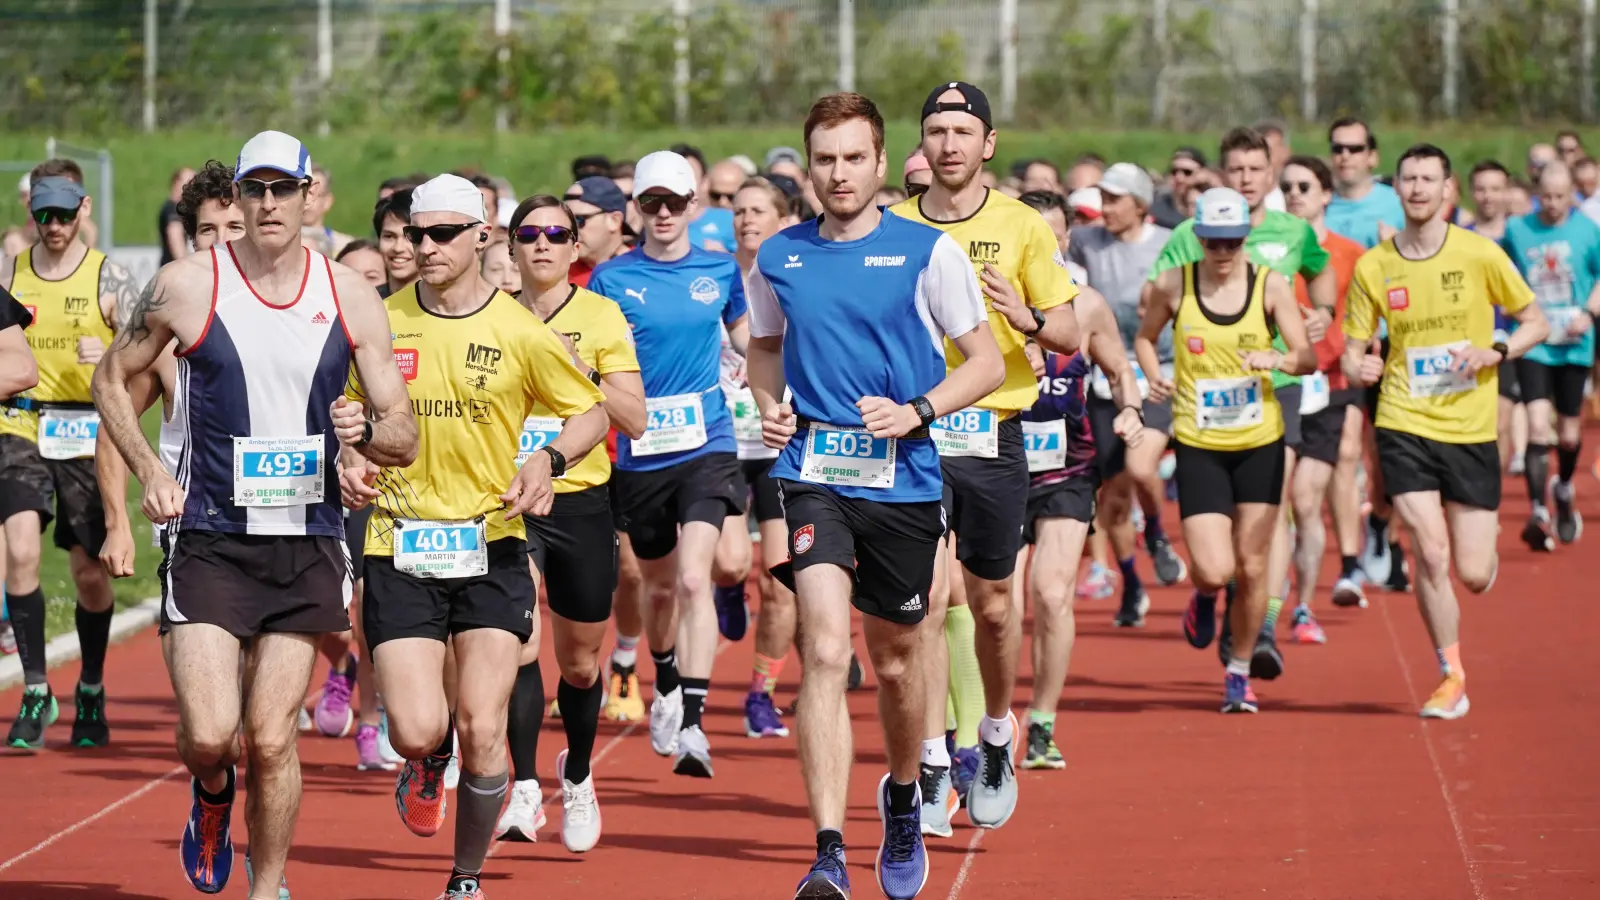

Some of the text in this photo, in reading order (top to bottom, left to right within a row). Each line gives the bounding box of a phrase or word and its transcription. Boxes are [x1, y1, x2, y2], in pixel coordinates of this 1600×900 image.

[969, 241, 1001, 258] MTP
[864, 256, 906, 267] SPORTCAMP
[65, 297, 89, 311] MTP
[466, 343, 502, 367] MTP
[465, 361, 498, 375] Hersbruck
[646, 408, 687, 429] 428
[936, 412, 980, 432] 408
[54, 420, 91, 438] 404
[944, 431, 969, 440] BERND
[824, 432, 873, 457] 503
[257, 452, 306, 476] 493
[822, 466, 860, 478] DEPRAG
[256, 488, 296, 497] DEPRAG
[415, 528, 462, 551] 401
[424, 553, 456, 561] MARTIN
[415, 562, 455, 571] DEPRAG
[900, 603, 922, 611] adidas
